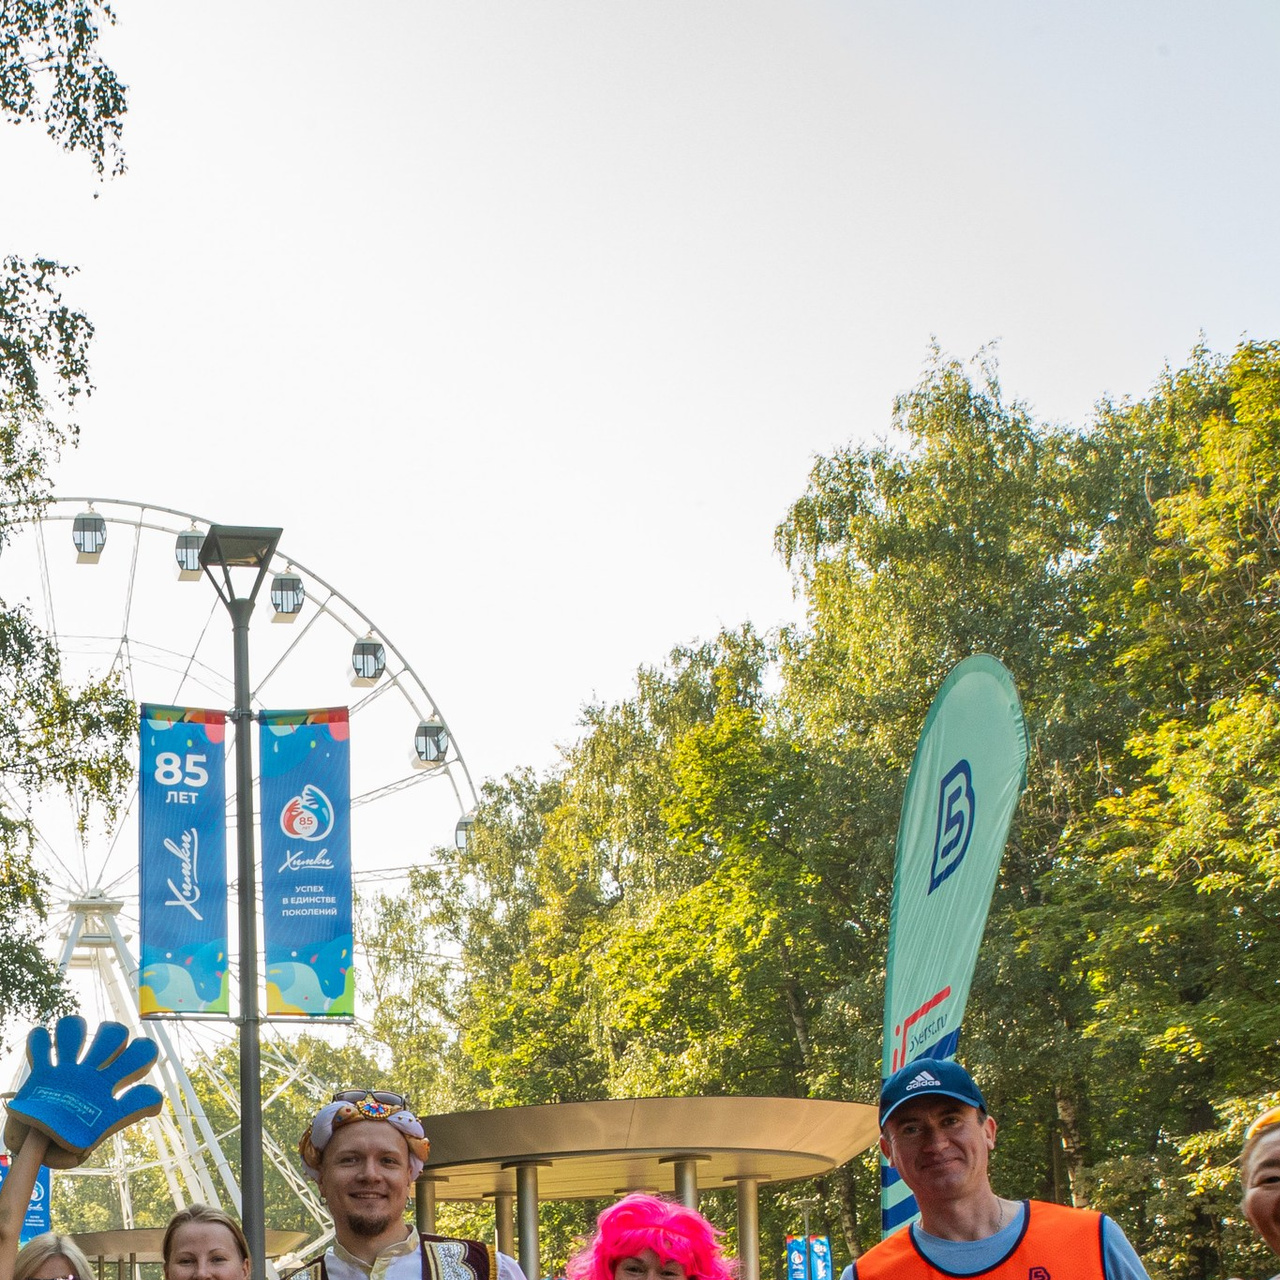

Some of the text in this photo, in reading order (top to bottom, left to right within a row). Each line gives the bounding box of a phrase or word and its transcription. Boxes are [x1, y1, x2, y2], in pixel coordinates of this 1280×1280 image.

[154, 752, 209, 787] 85
[166, 790, 198, 804] ЛЕТ
[299, 817, 313, 825] 85
[279, 849, 334, 873] Химки
[164, 828, 203, 921] Химки
[283, 896, 336, 905] В ЕДИНСТВЕ
[282, 907, 337, 916] ПОКОЛЕНИЙ
[906, 1079, 941, 1091] adidas
